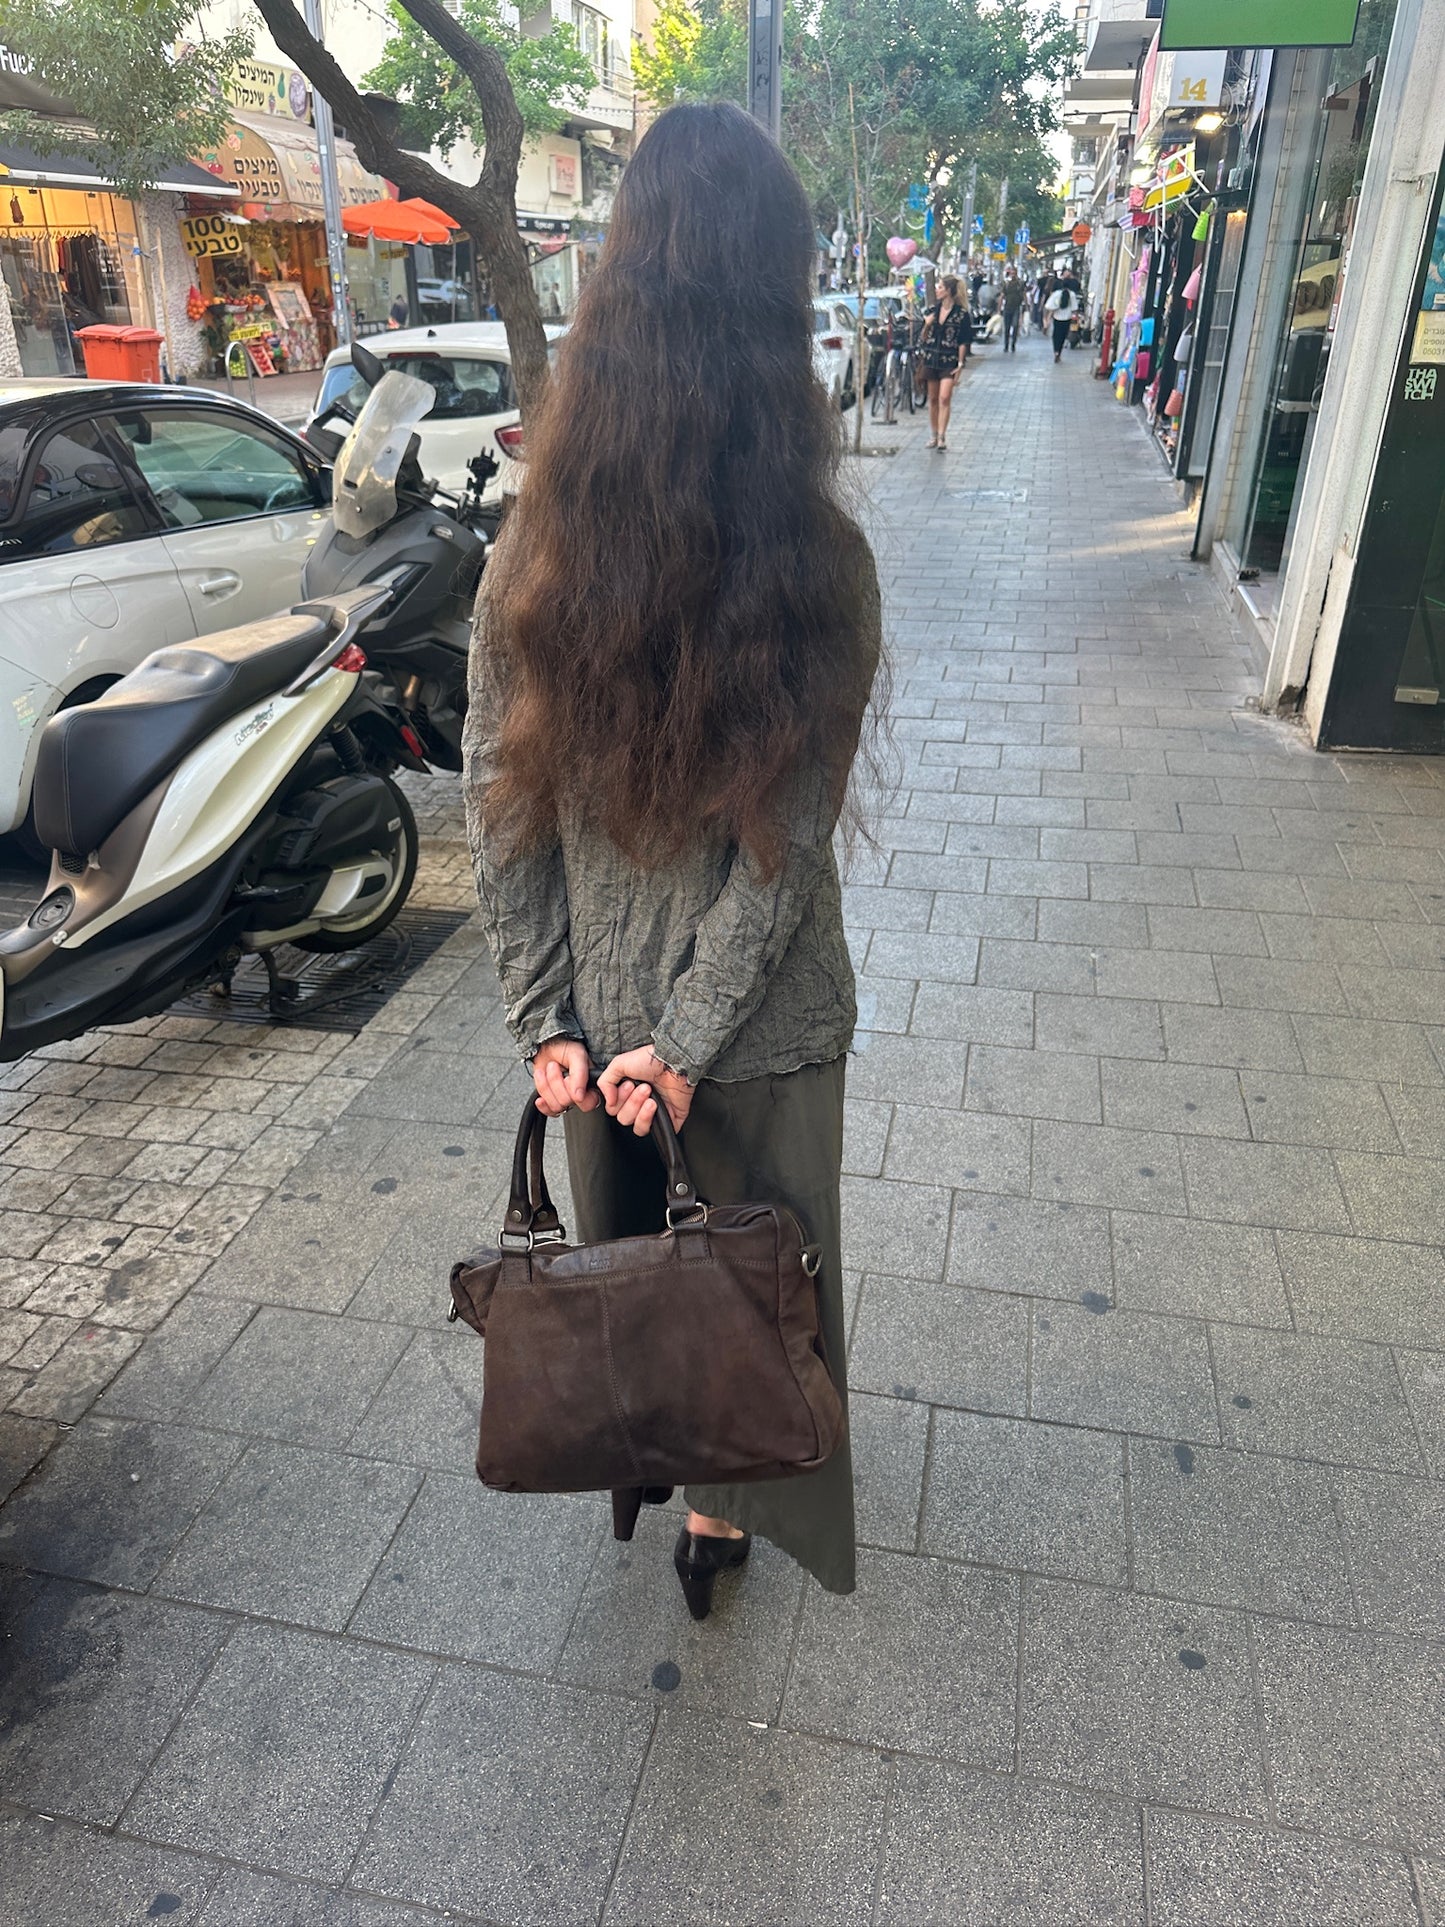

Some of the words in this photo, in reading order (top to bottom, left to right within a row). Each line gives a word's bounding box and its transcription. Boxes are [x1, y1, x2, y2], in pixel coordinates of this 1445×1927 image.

[238, 63, 276, 87] המיצים
[233, 86, 265, 107] שינקין
[1177, 77, 1207, 101] 14
[233, 159, 278, 175] מיצים
[186, 236, 240, 257] טבעי
